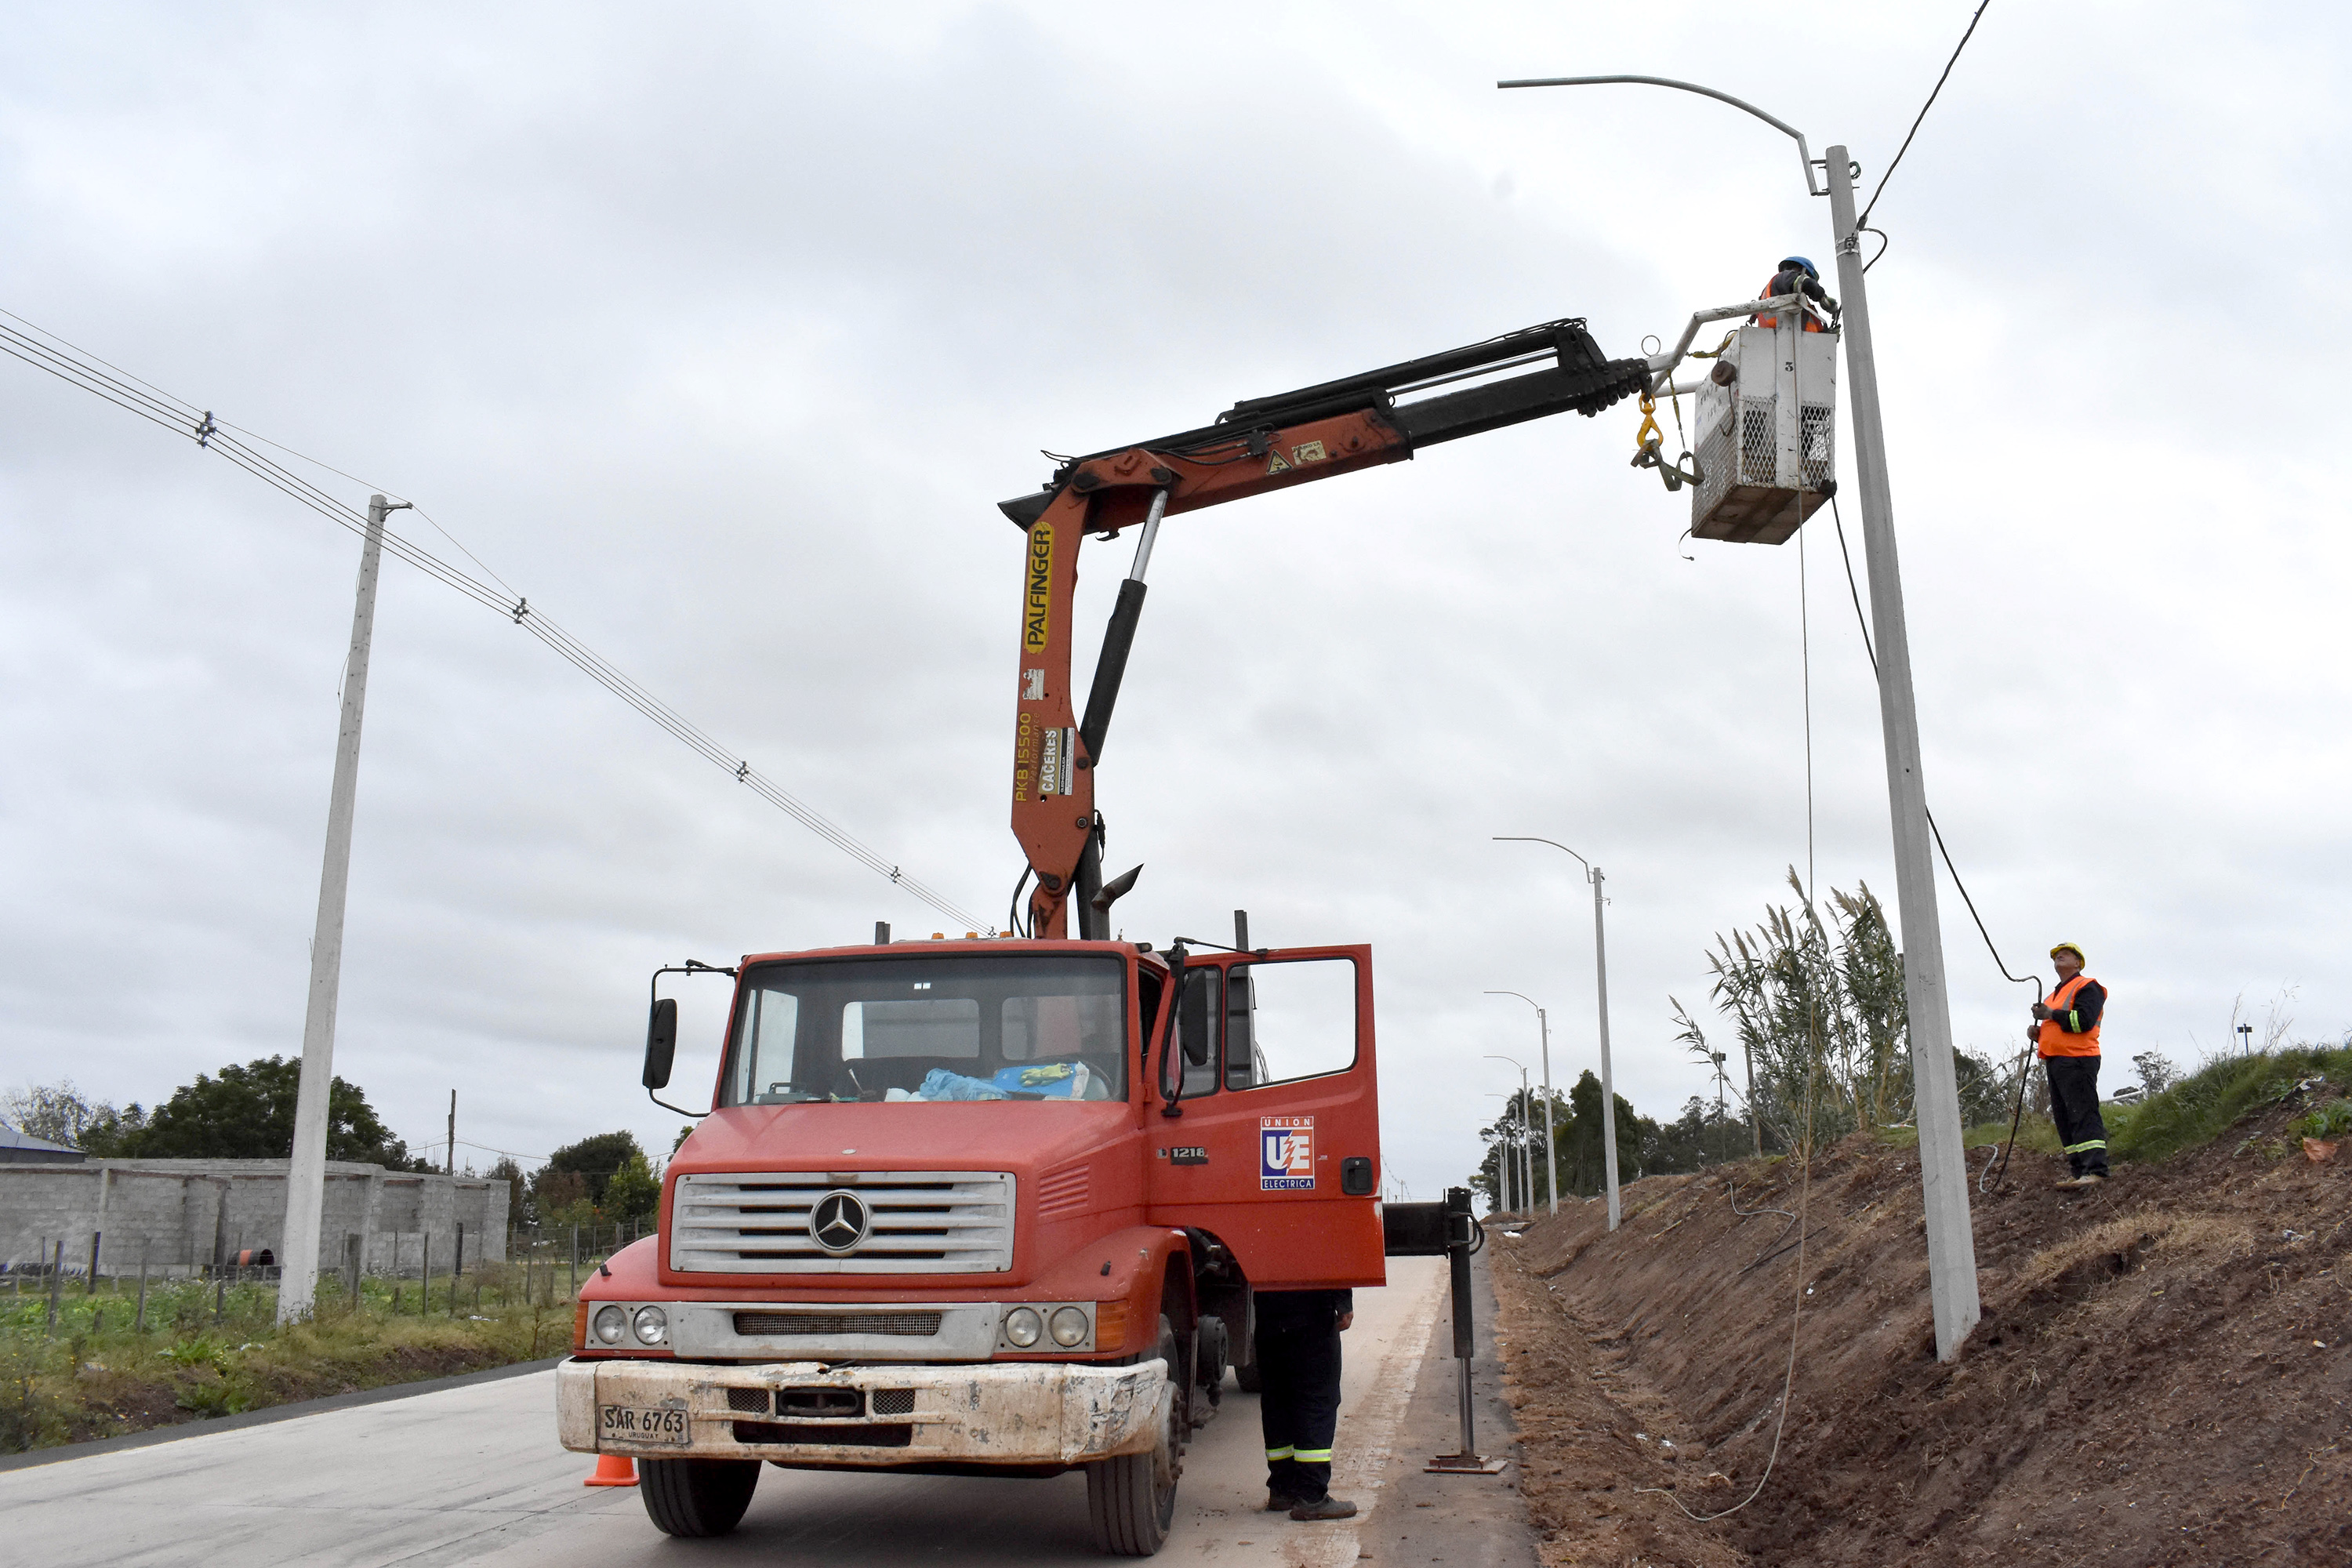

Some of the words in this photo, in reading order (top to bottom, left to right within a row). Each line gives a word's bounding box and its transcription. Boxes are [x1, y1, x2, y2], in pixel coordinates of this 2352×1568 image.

[1784, 361, 1794, 372] 3
[1027, 529, 1051, 645] PALFINGER
[1018, 713, 1032, 764] 15500
[1029, 713, 1040, 782] Performance
[1041, 730, 1058, 792] CACERES
[1016, 768, 1029, 801] PKB
[1265, 1118, 1310, 1127] UNION
[1172, 1147, 1205, 1158] 1218
[1266, 1135, 1309, 1170] UE
[1265, 1179, 1312, 1188] ELECTRICA
[604, 1407, 635, 1430] SAR
[643, 1410, 683, 1433] 6763
